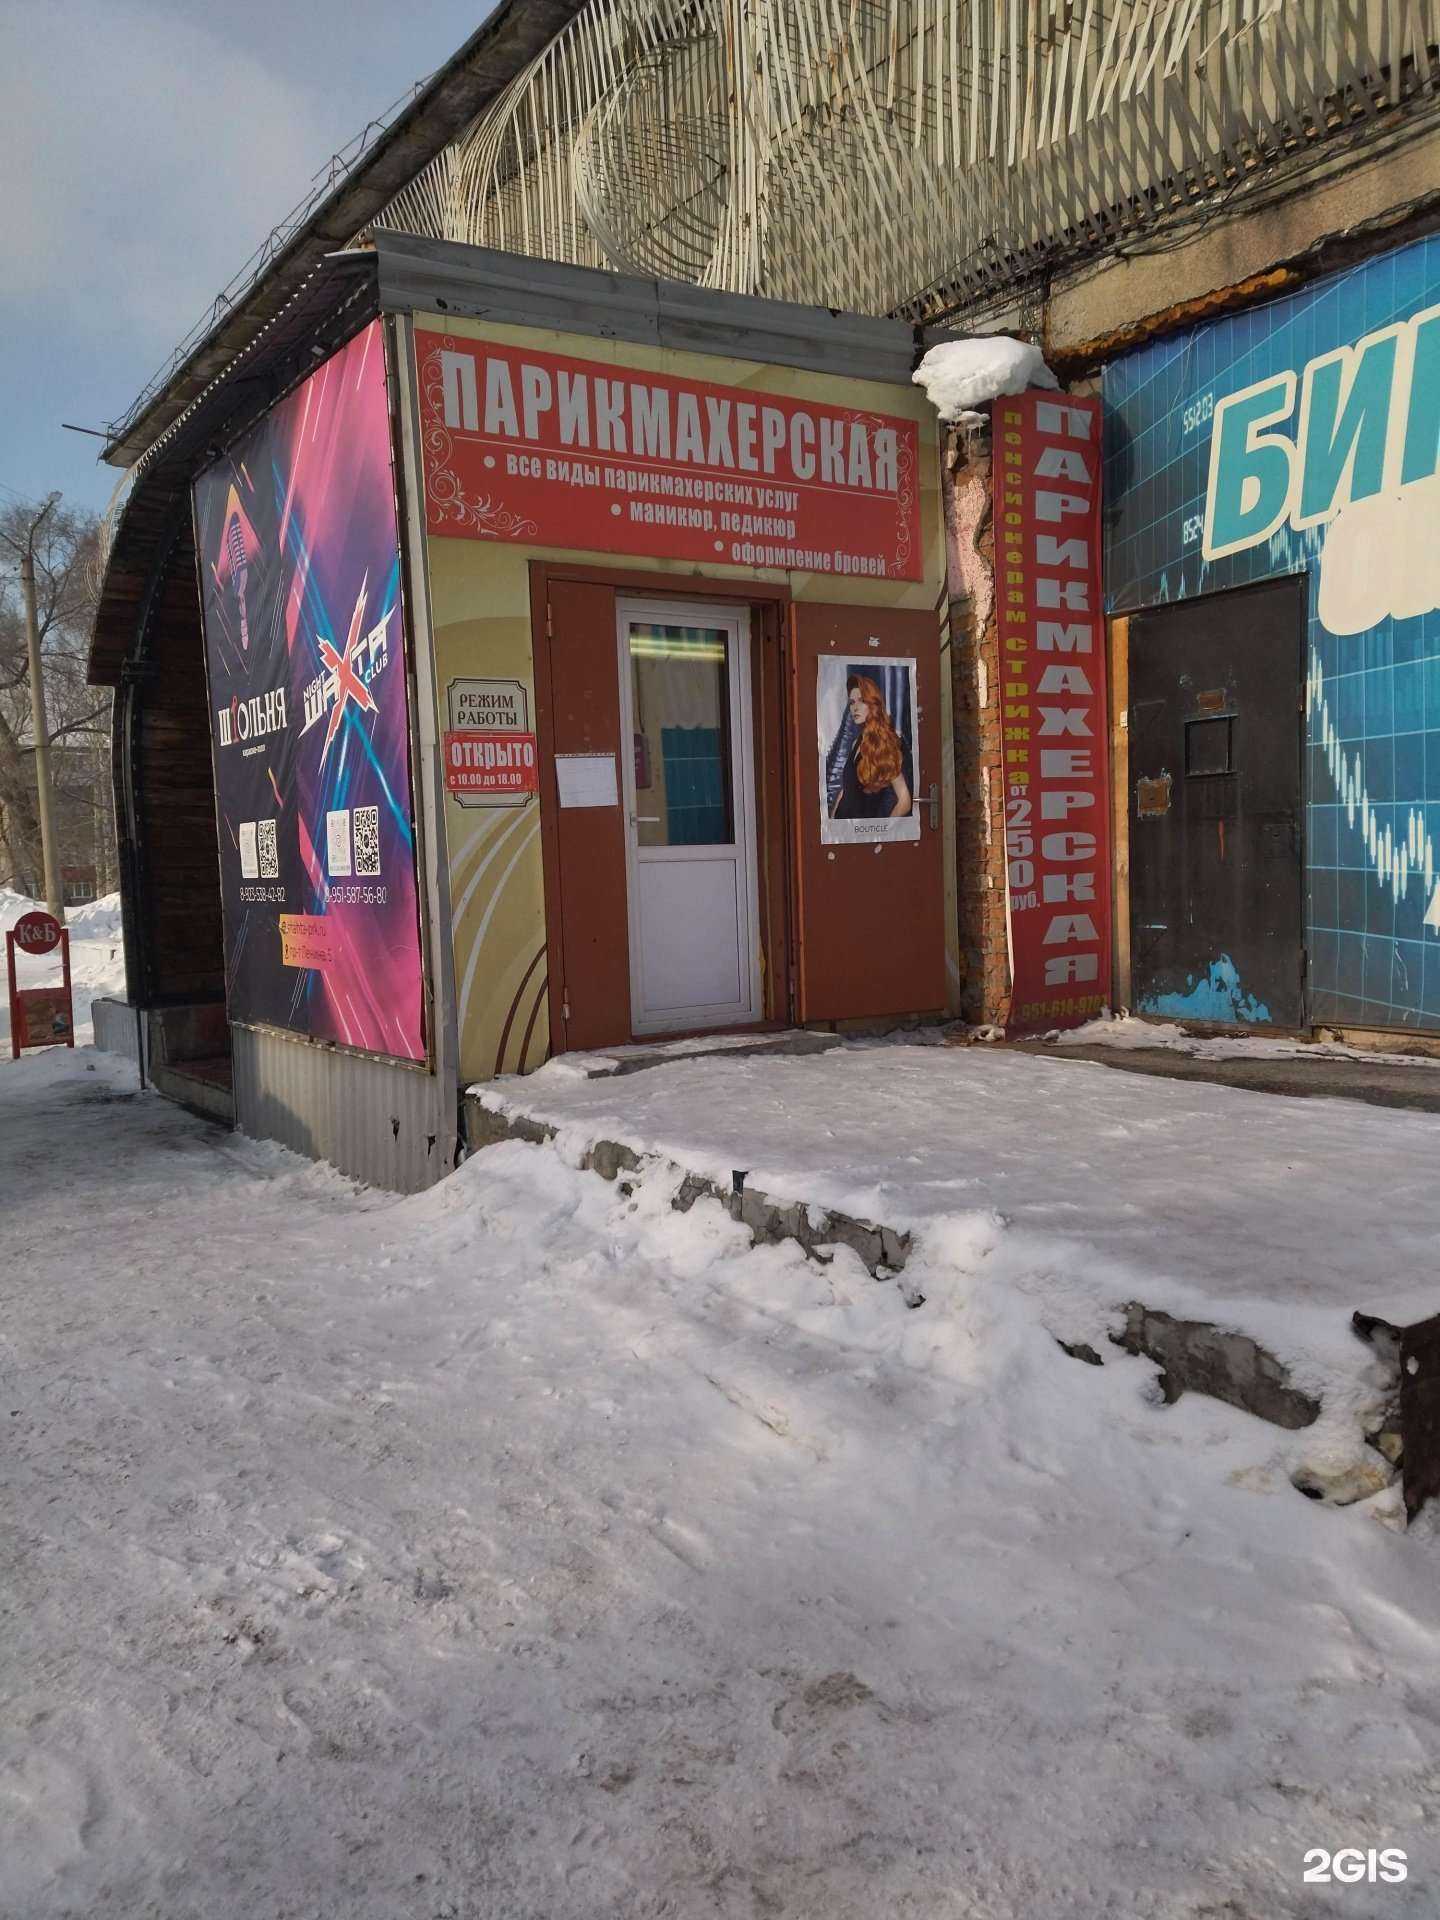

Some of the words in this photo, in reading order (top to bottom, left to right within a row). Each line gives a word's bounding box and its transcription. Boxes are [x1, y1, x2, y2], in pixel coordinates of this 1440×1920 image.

[441, 350, 898, 491] ПАРИКМАХЕРСКАЯ
[546, 459, 600, 487] виды
[604, 467, 754, 504] парикмахерских
[756, 487, 799, 512] услуг
[630, 501, 717, 533] маникюр,
[720, 511, 796, 540] педикюр
[732, 542, 831, 571] оформление
[834, 550, 886, 576] бровей
[303, 670, 326, 699] NIGHT
[364, 652, 388, 684] CLUB
[459, 693, 514, 709] РЕЖИМ
[1034, 401, 1100, 986] ПАРИКМАХЕРСКАЯ
[458, 711, 517, 726] РАБОТЫ
[483, 775, 496, 787] до
[1006, 799, 1034, 888] 250
